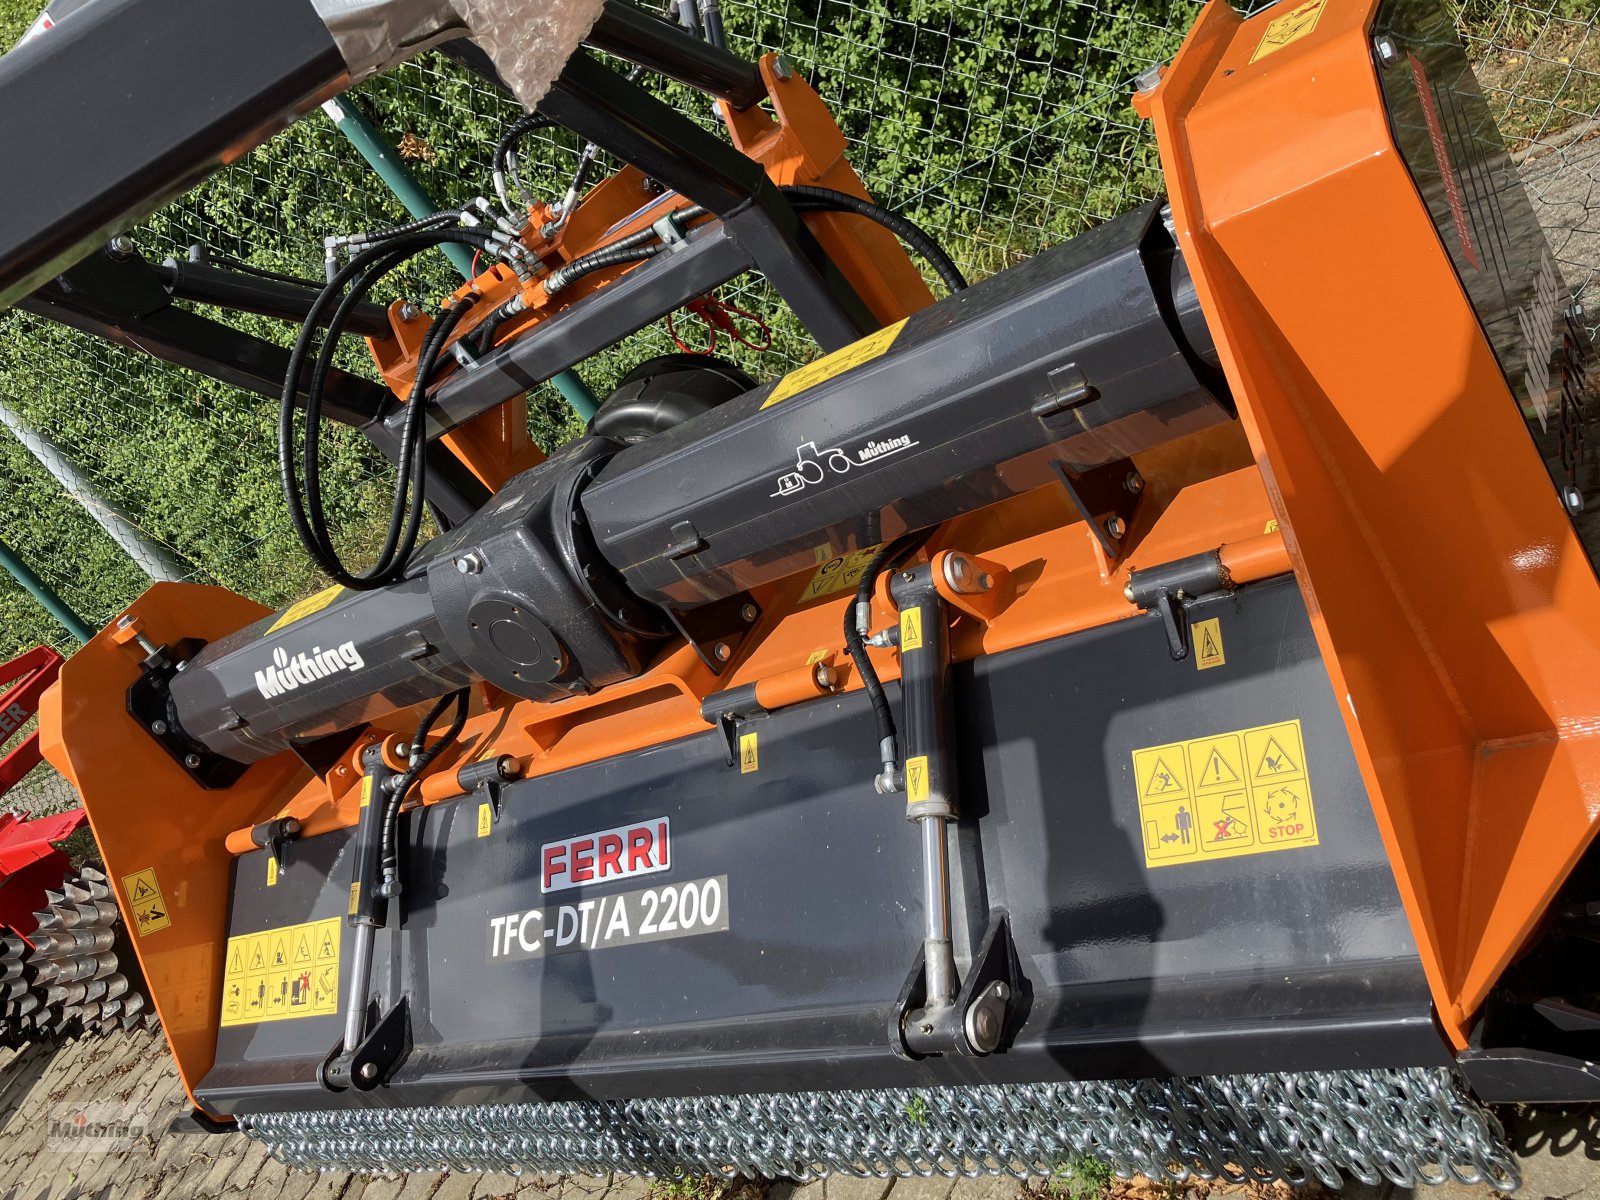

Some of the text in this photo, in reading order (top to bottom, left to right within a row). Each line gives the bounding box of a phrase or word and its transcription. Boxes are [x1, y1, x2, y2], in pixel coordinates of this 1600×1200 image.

[858, 434, 911, 461] Müthing
[254, 640, 365, 700] Müthing
[543, 822, 668, 888] FERRI
[1268, 823, 1304, 838] STOP
[490, 878, 721, 957] TFC-DT/A 2200
